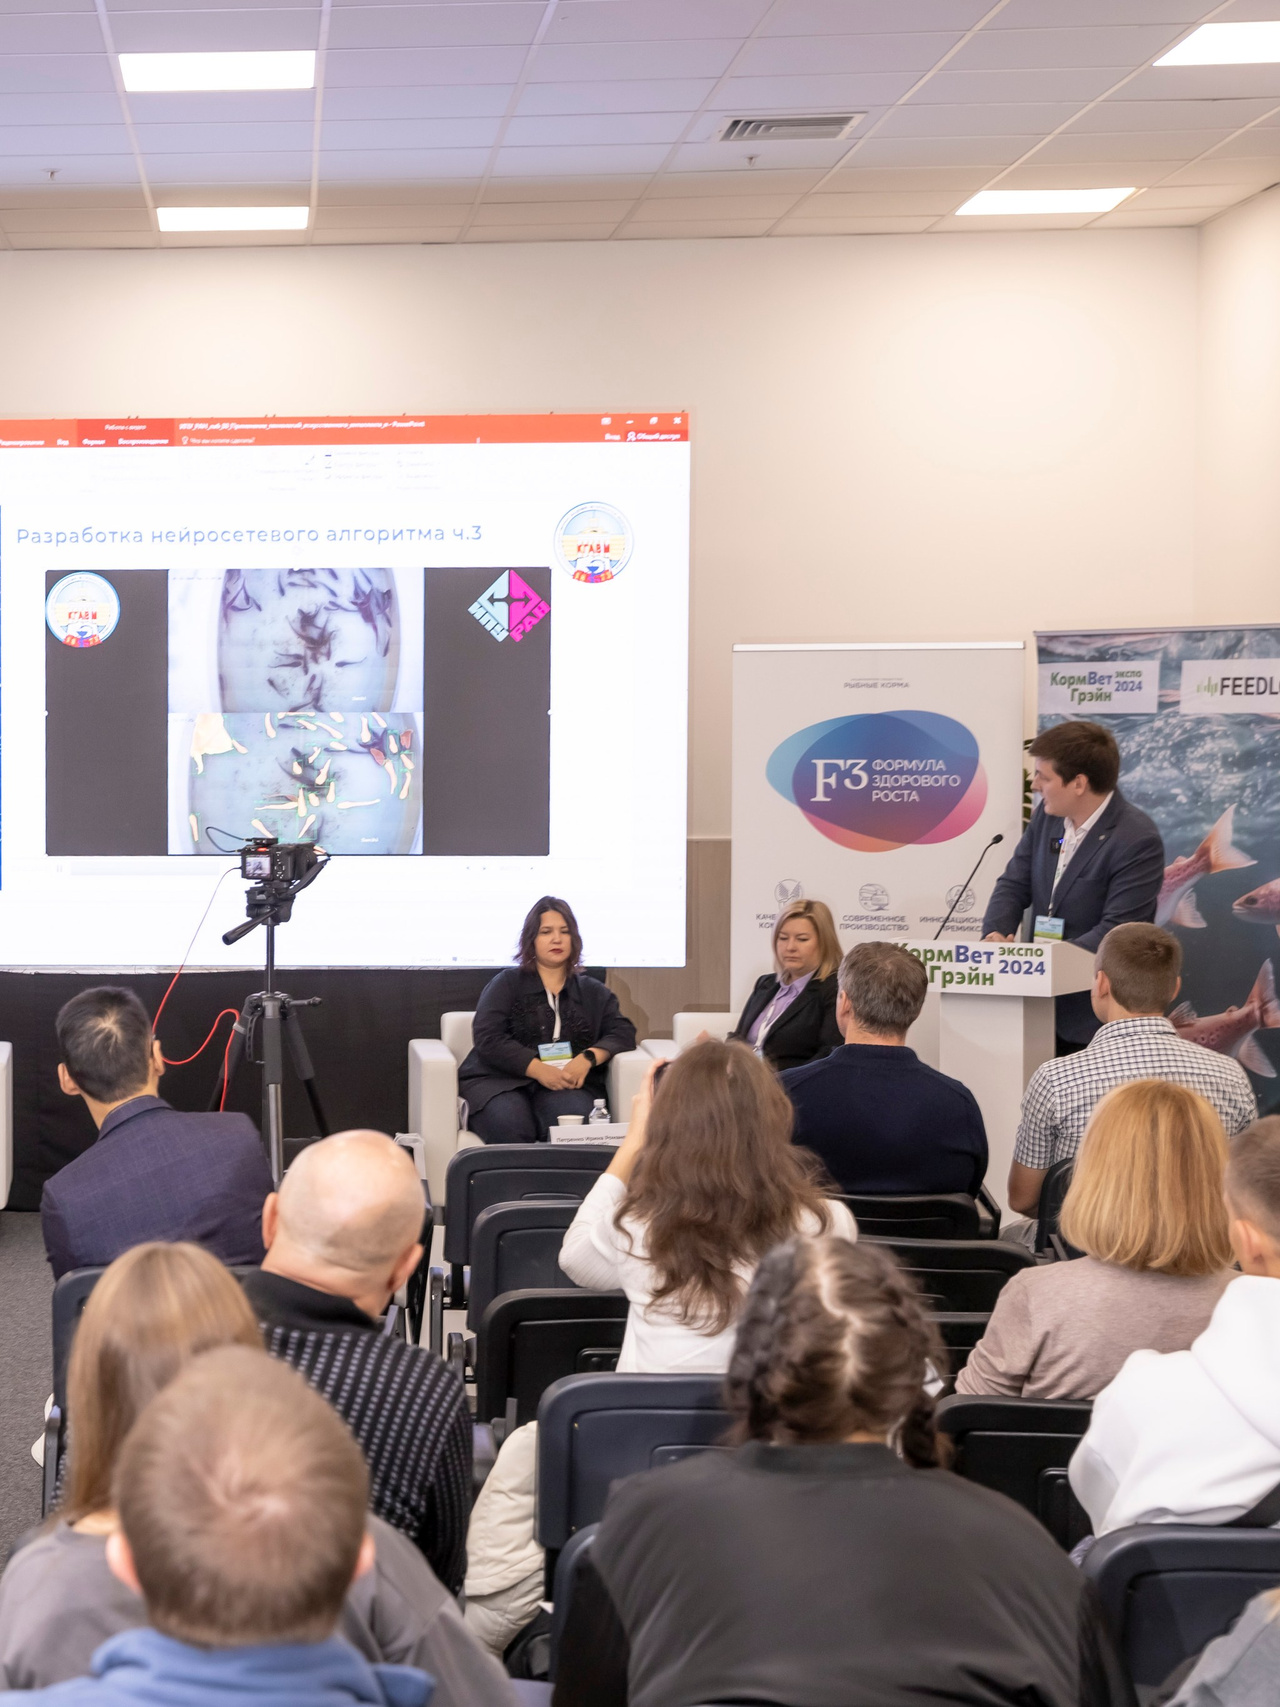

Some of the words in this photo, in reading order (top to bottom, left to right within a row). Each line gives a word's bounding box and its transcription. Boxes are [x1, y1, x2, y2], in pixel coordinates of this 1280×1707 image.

[17, 526, 143, 547] Разработка
[151, 526, 319, 546] нейросетевого
[326, 526, 445, 544] алгоритма
[452, 525, 482, 541] ч.3
[880, 681, 910, 689] КОРМА
[1050, 671, 1112, 689] КормВет
[1114, 670, 1142, 679] экспо
[1220, 676, 1280, 696] FEEDL
[1070, 688, 1112, 705] Грэйн
[1114, 680, 1143, 692] 2024
[871, 758, 947, 772] ФОРМУЛА
[810, 758, 869, 802] F3
[872, 774, 962, 788] ЗДОРОВОГО
[872, 789, 920, 802] РОСТА
[842, 914, 906, 923] СОВРЕМЕННОЕ
[839, 922, 910, 932] ПРОИЗВОДСТВО
[998, 947, 1044, 958] экспо
[929, 965, 994, 989] Грэйн
[998, 959, 1046, 976] 2024
